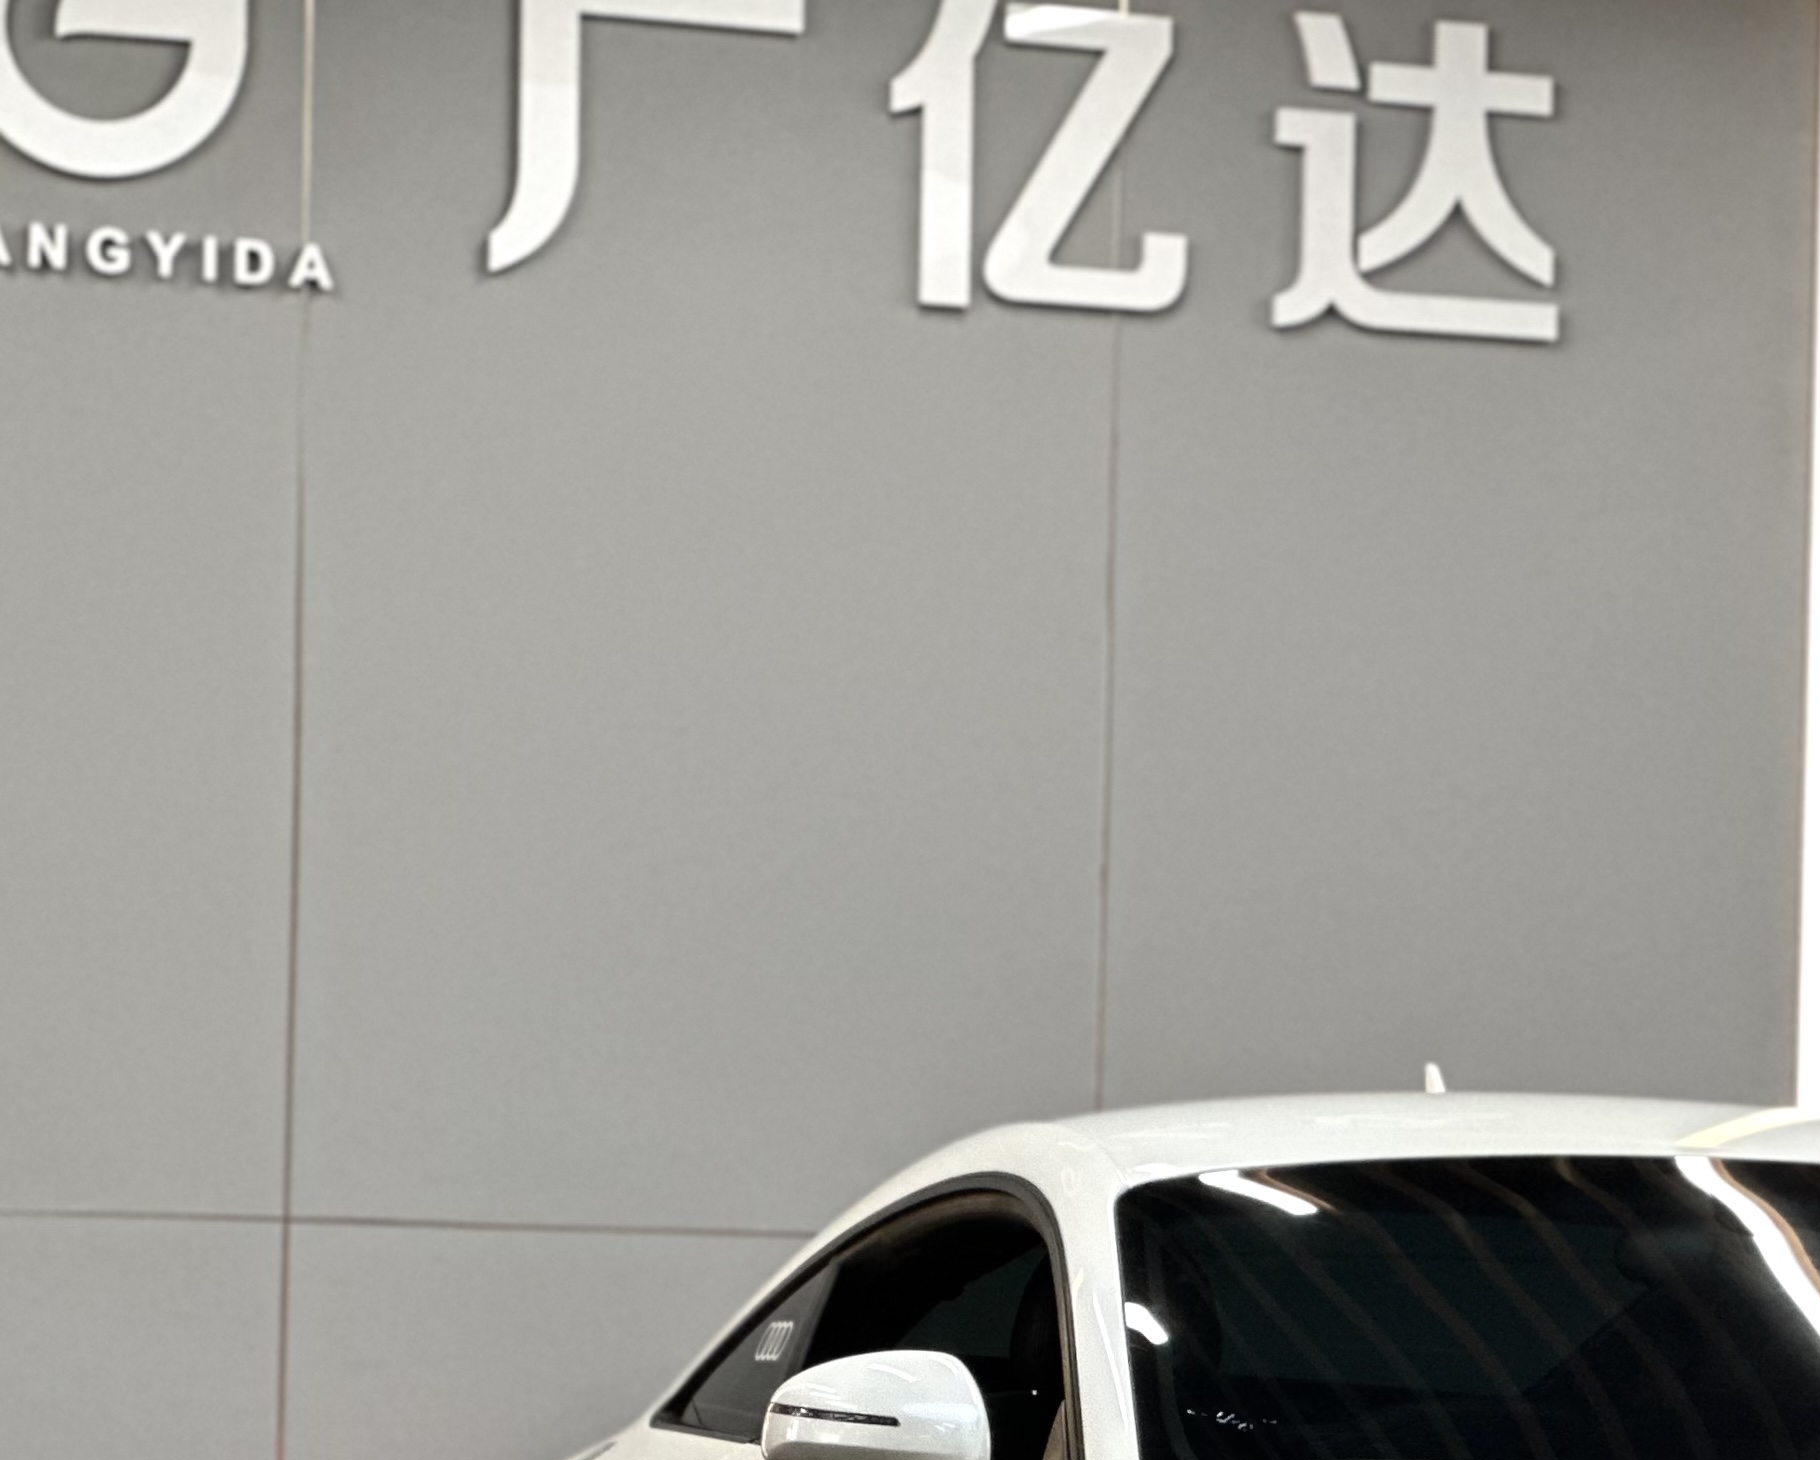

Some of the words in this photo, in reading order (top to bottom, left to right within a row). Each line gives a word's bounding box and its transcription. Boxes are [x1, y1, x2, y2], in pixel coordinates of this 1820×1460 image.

[0, 222, 333, 290] NGYIDA
[488, 0, 1558, 341] 广亿达
